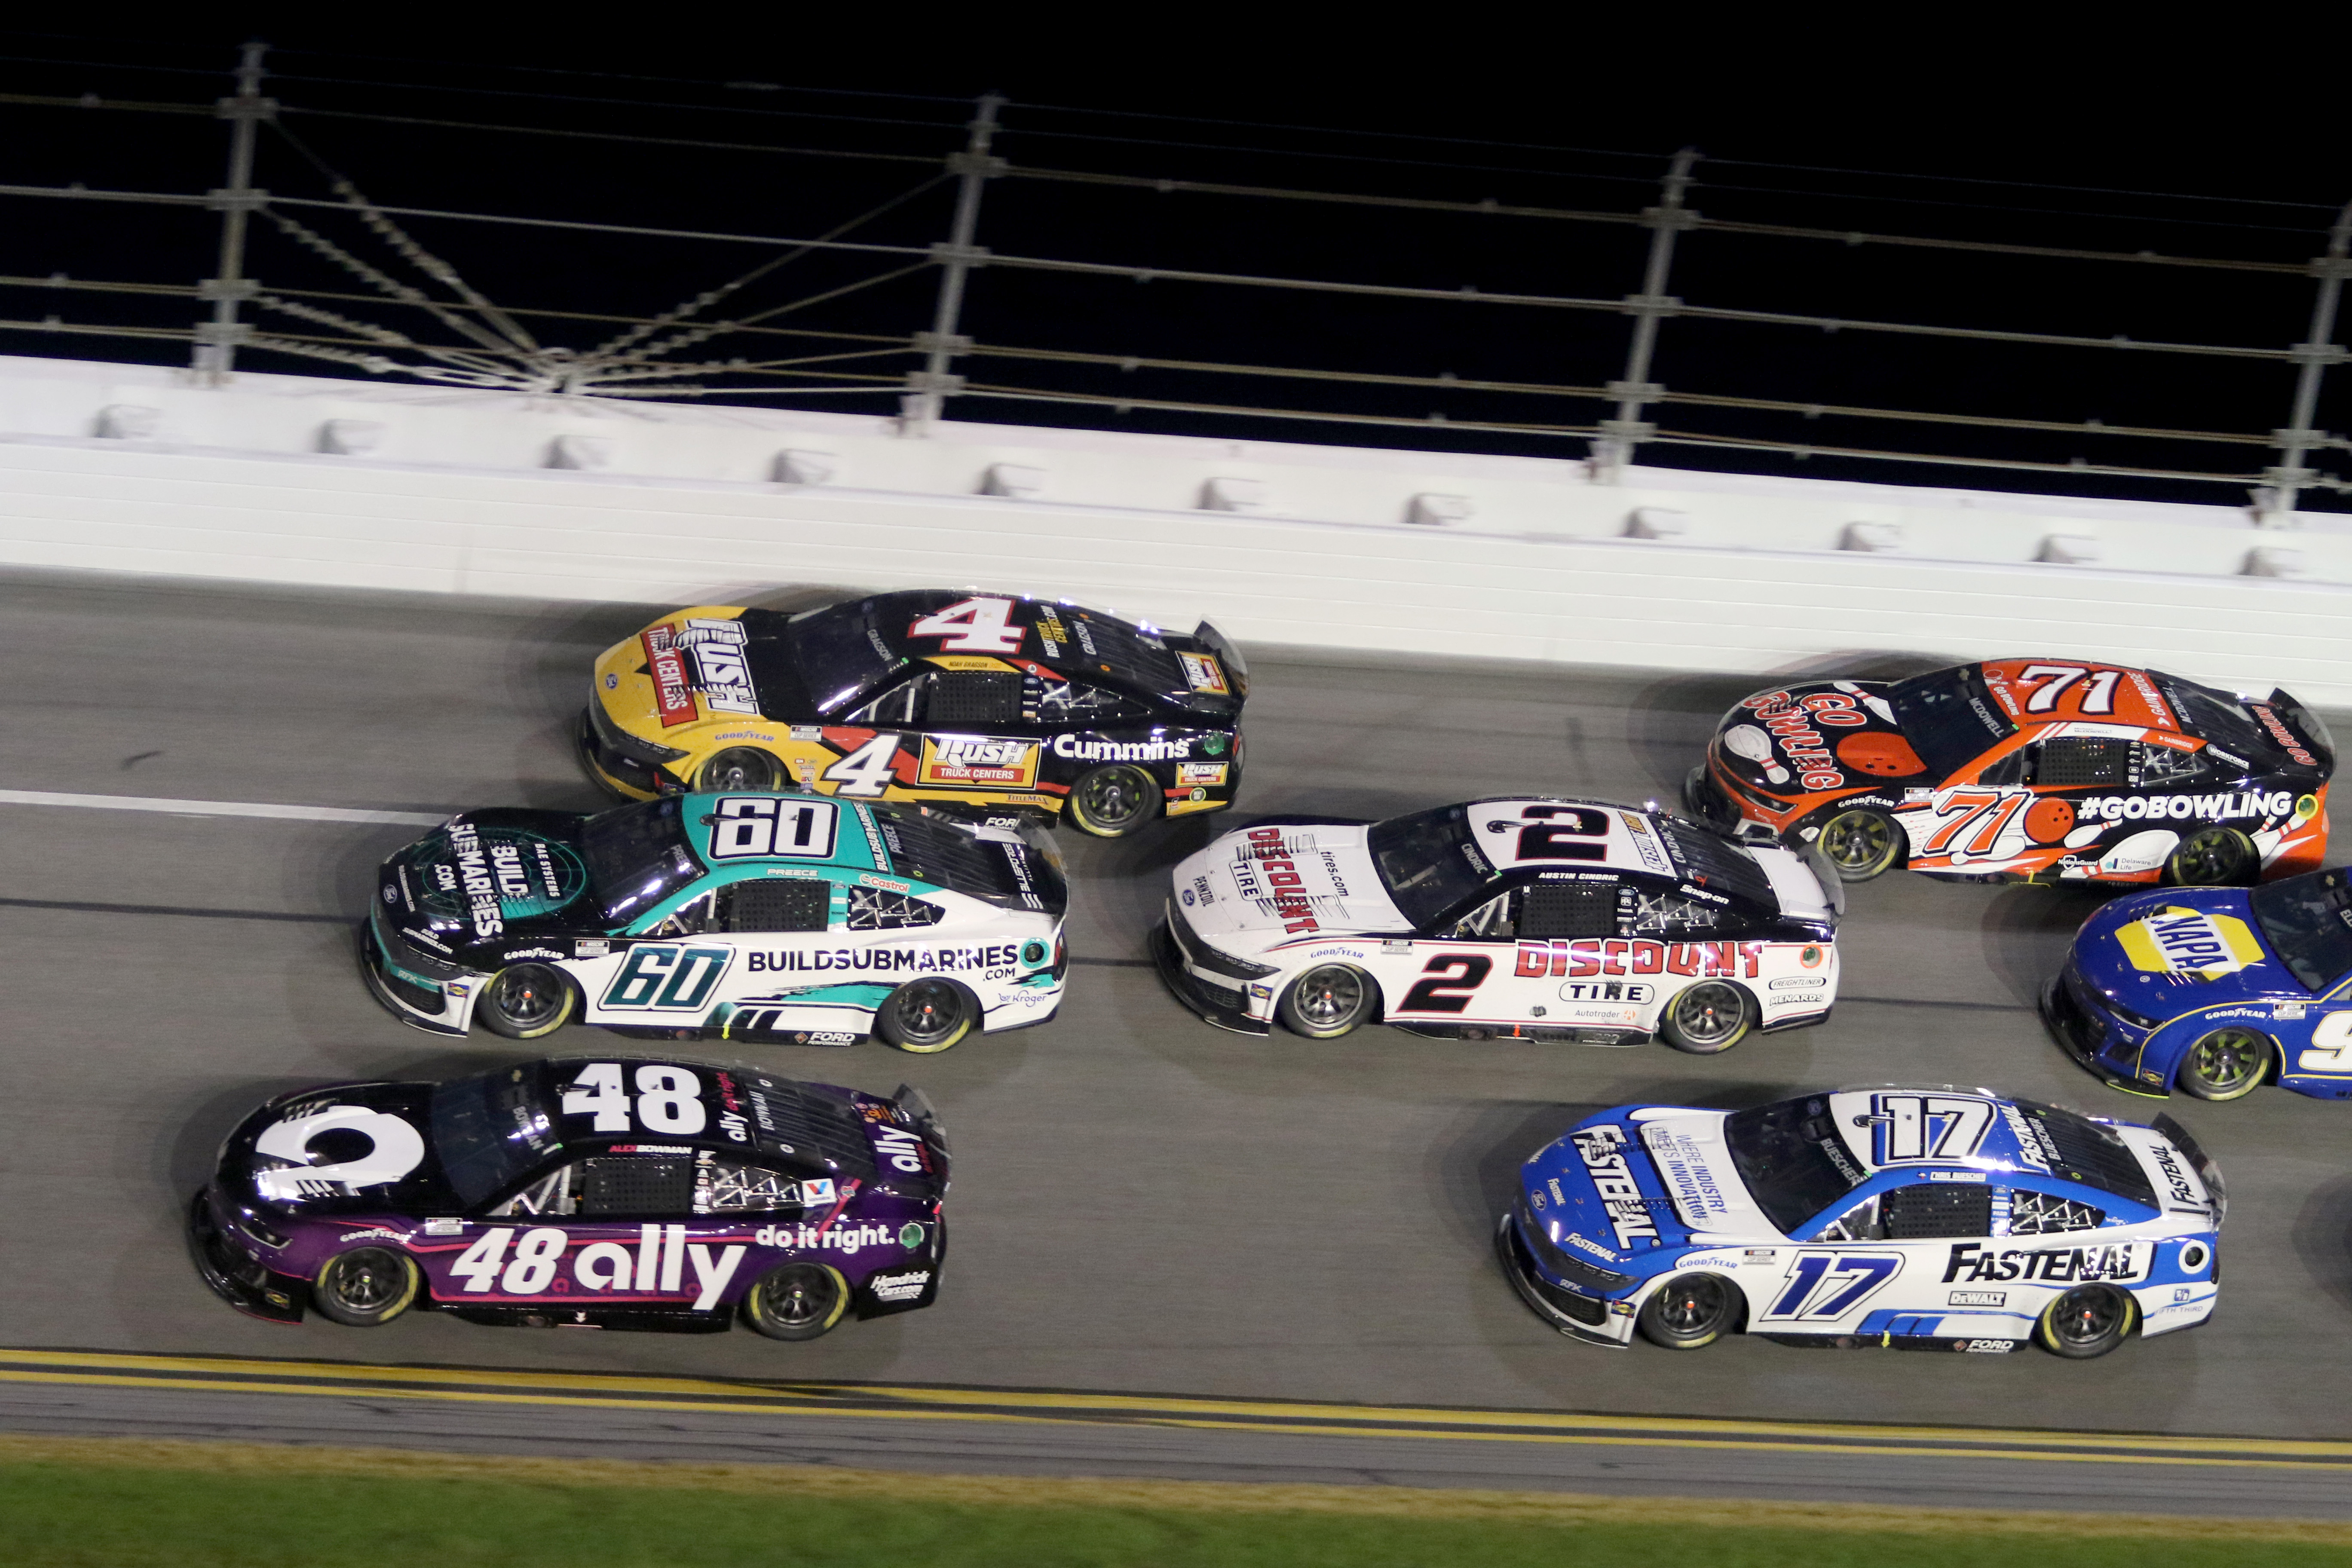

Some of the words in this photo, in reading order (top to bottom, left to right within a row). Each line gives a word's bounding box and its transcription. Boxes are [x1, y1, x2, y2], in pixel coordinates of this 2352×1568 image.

[908, 596, 1027, 655] 4
[867, 628, 893, 662] GRAGSON
[673, 619, 760, 715] RUSH
[1182, 655, 1211, 688] RUSH
[1994, 686, 2003, 696] GO
[2000, 693, 2019, 715] BOWLING
[2018, 664, 2125, 714] 71
[2127, 671, 2166, 716] GAINBRIDGE
[1800, 692, 1867, 726] GO
[1969, 697, 2005, 737] MCDOWELL
[715, 730, 775, 741] GOODYEAR
[1743, 691, 1844, 790] BOWLING
[2252, 705, 2300, 747] BOWLING
[933, 738, 1029, 768] RUSH
[1054, 735, 1189, 761] Cummins
[2164, 736, 2193, 748] GAINBRIDGE
[2210, 747, 2249, 767] WORKFORCE
[2288, 748, 2316, 766] GO
[820, 733, 902, 797] 4
[941, 768, 971, 778] TRUCK
[973, 769, 1014, 779] CENTERS
[1183, 764, 1222, 777] RUSH
[1008, 794, 1048, 804] TITLEMAX
[1838, 795, 1895, 808] GOODYEAR
[2077, 791, 2292, 819] #GOBOWLING
[708, 796, 840, 860] 60
[1515, 805, 1609, 861] 2
[1923, 791, 2030, 856] 71
[535, 842, 546, 860] BAE
[1461, 843, 1489, 874] CINDRIC
[435, 863, 457, 891] .COM
[449, 823, 503, 937] SUBMARINES
[490, 845, 529, 895] BUILD
[540, 861, 560, 897] SYSTEMS
[767, 868, 818, 876] PREECE
[1002, 843, 1030, 893] BLUEFORGE
[1233, 863, 1258, 896] TIRE
[1248, 829, 1319, 934] DISCOUNT
[1320, 851, 1348, 896] tires.com
[871, 877, 909, 892] Castrol
[1193, 876, 1215, 906] PENNZOIL
[1680, 884, 1730, 905] Snap-on
[420, 928, 439, 940] BUILD
[2150, 916, 2228, 971] NAPA
[504, 947, 565, 960] GOODYEAR
[748, 945, 1017, 972] BUILDSUBMARINES
[1311, 947, 1364, 959] GOODYEAR
[1515, 939, 1762, 978] DISCOUNT
[600, 944, 733, 1010] 60
[983, 968, 1015, 981] .COM
[1396, 953, 1493, 1013] 2
[1773, 978, 1821, 987] FREIGHTLINER
[1013, 992, 1046, 1006] Kroger
[1571, 985, 1643, 1000] TIRE
[1769, 994, 1824, 1006] MENARDS
[1575, 1010, 1620, 1018] Autotrader
[2205, 1008, 2266, 1020] GOODYEAR
[809, 1032, 855, 1042] FORD
[2299, 1010, 2352, 1071] 9
[563, 1063, 706, 1134] 48
[512, 1106, 544, 1150] BOWAN
[720, 1111, 748, 1142] ally
[1882, 1096, 1994, 1161] 17
[1999, 1104, 2051, 1171] FASTENAL
[2027, 1118, 2062, 1160] BUESCHER
[874, 1125, 922, 1173] ally
[1820, 1138, 1861, 1186] BUESCHER
[1572, 1124, 1657, 1249] FASTENAL
[1654, 1129, 1678, 1158] MEETS
[1668, 1159, 1709, 1220] INNOVATION
[1676, 1134, 1698, 1164] WHERE
[1693, 1164, 1727, 1213] INDUSTRY
[1931, 1172, 1950, 1180] CHRIS
[1952, 1173, 1986, 1181] BUESCHER
[2149, 1144, 2200, 1205] FASTENAL
[1547, 1178, 1567, 1206] FASTENAL
[340, 1228, 411, 1243] GOODYEAR
[755, 1225, 792, 1247] do
[798, 1225, 818, 1248] it
[823, 1224, 895, 1254] right.
[1565, 1232, 1617, 1262] FASTENAL
[449, 1228, 568, 1294] 48
[574, 1224, 747, 1310] ally
[1680, 1257, 1737, 1269] GOODYEAR
[1942, 1243, 2139, 1283] FASTENAL
[870, 1271, 930, 1289] Hendrick
[1560, 1279, 1582, 1292] RFK
[1766, 1253, 1903, 1319] 17
[1951, 1293, 2005, 1303] DEWALT
[1969, 1340, 2014, 1350] FORD
